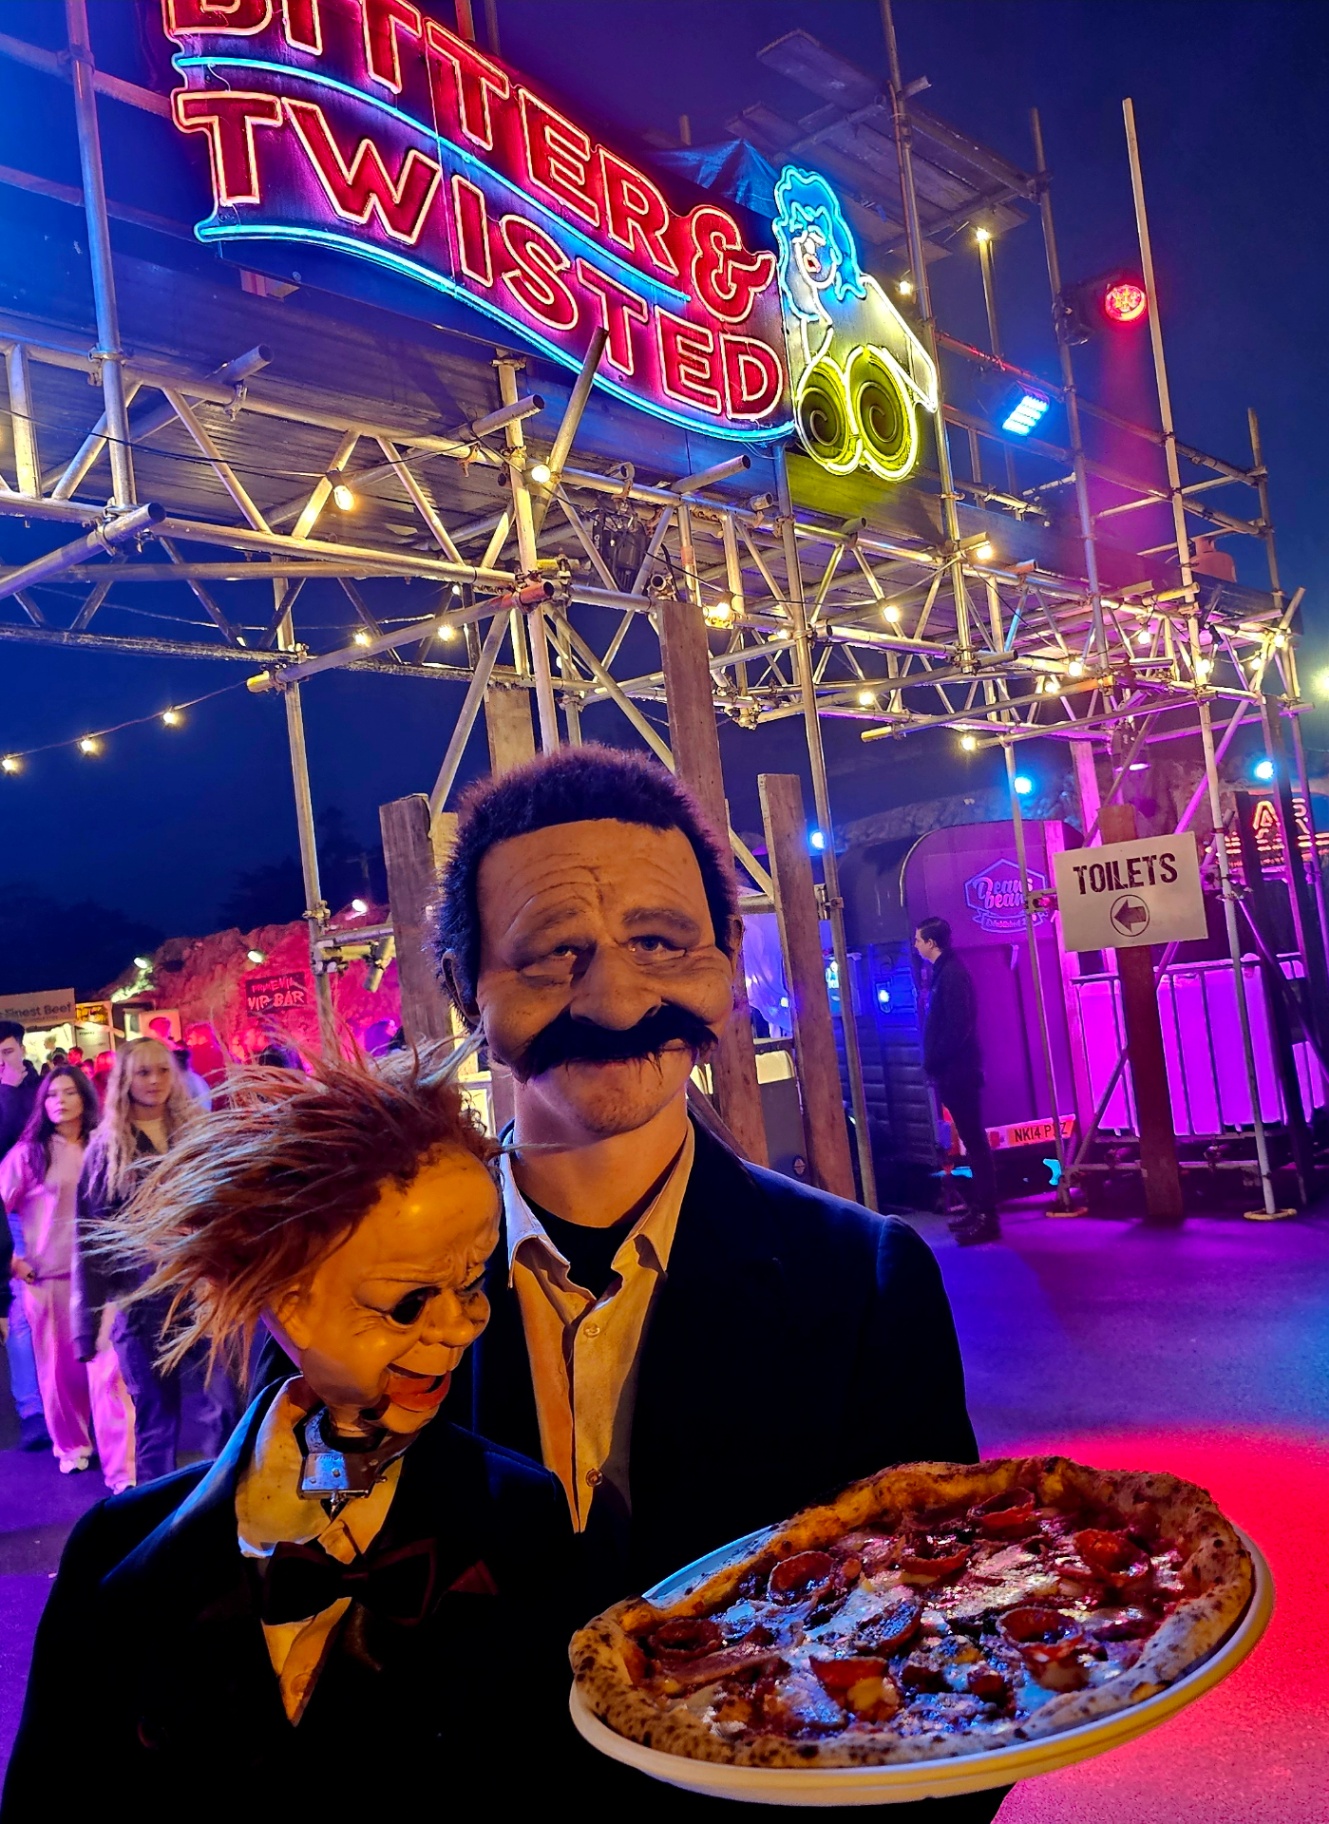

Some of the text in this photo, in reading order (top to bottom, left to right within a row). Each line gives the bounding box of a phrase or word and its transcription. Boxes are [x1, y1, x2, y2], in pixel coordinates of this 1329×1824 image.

[176, 90, 785, 422] TWISTED
[690, 203, 776, 324] &
[1073, 852, 1178, 895] TOILETS
[43, 1002, 72, 1015] Beef
[247, 990, 305, 1012] VIP BAR
[1014, 1121, 1069, 1143] NK14 PZ
